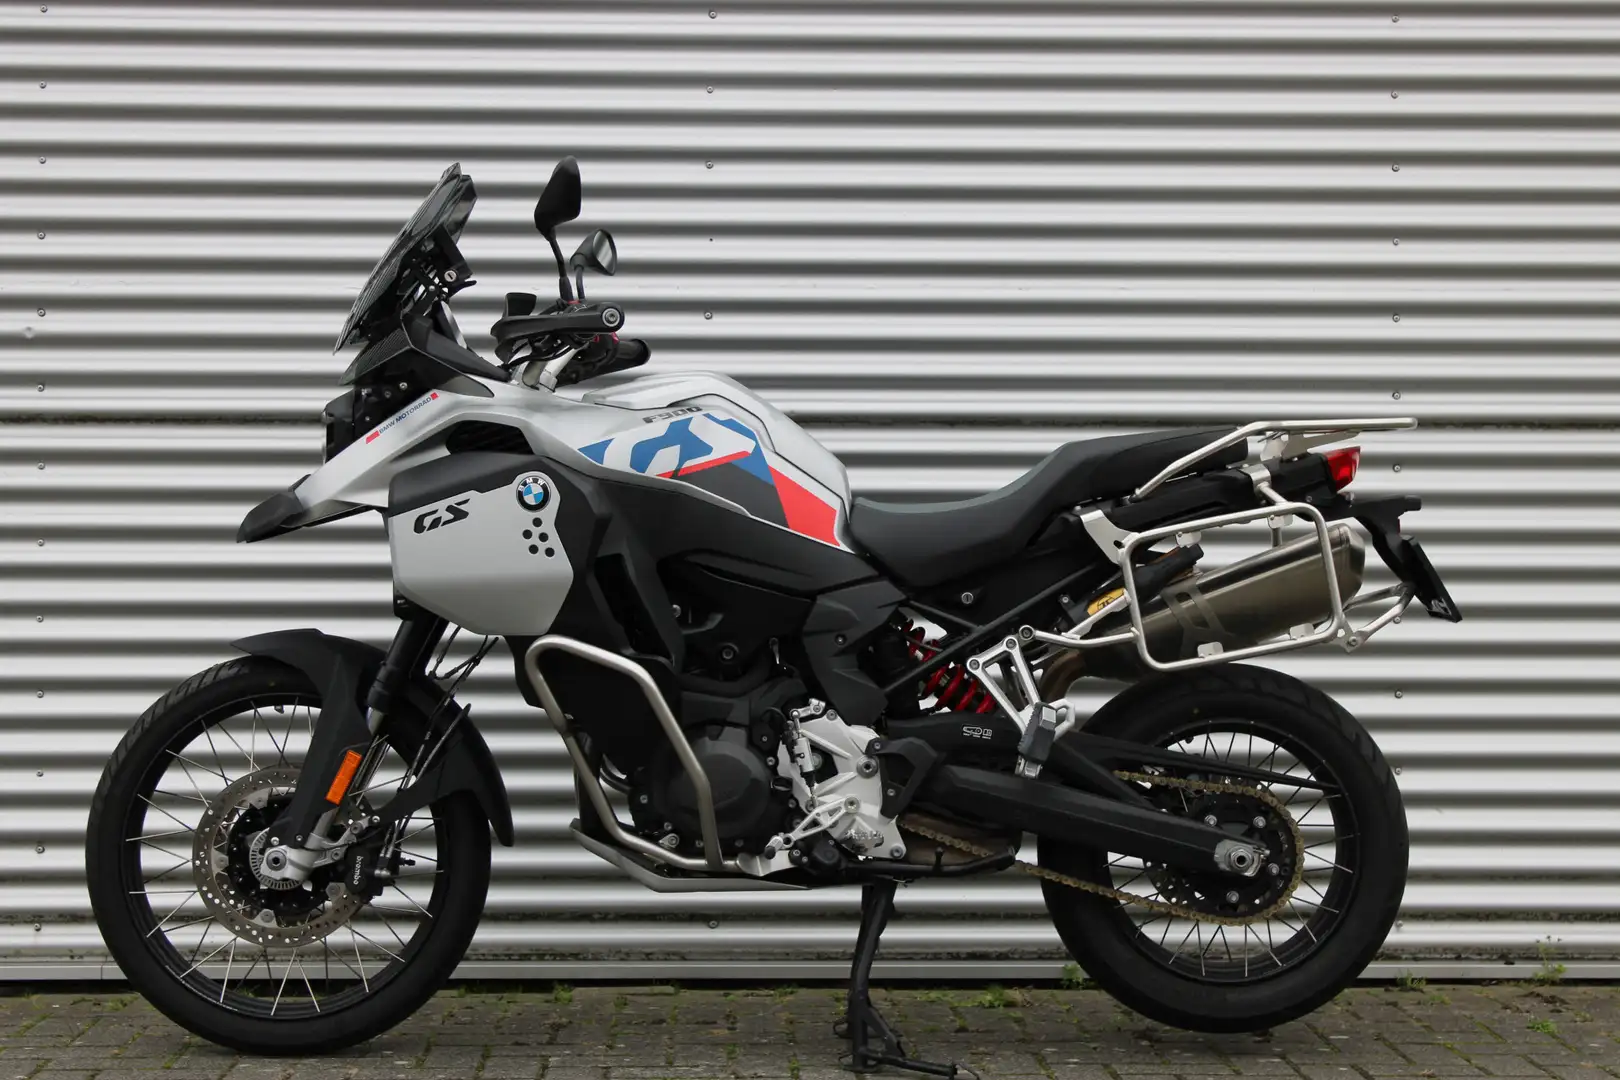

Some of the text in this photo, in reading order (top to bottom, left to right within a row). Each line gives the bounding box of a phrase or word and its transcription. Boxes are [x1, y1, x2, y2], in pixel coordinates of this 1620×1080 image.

[379, 396, 432, 434] BMW MOTORRAD
[642, 406, 703, 424] F900
[413, 498, 470, 534] GS
[353, 855, 364, 885] brembo
